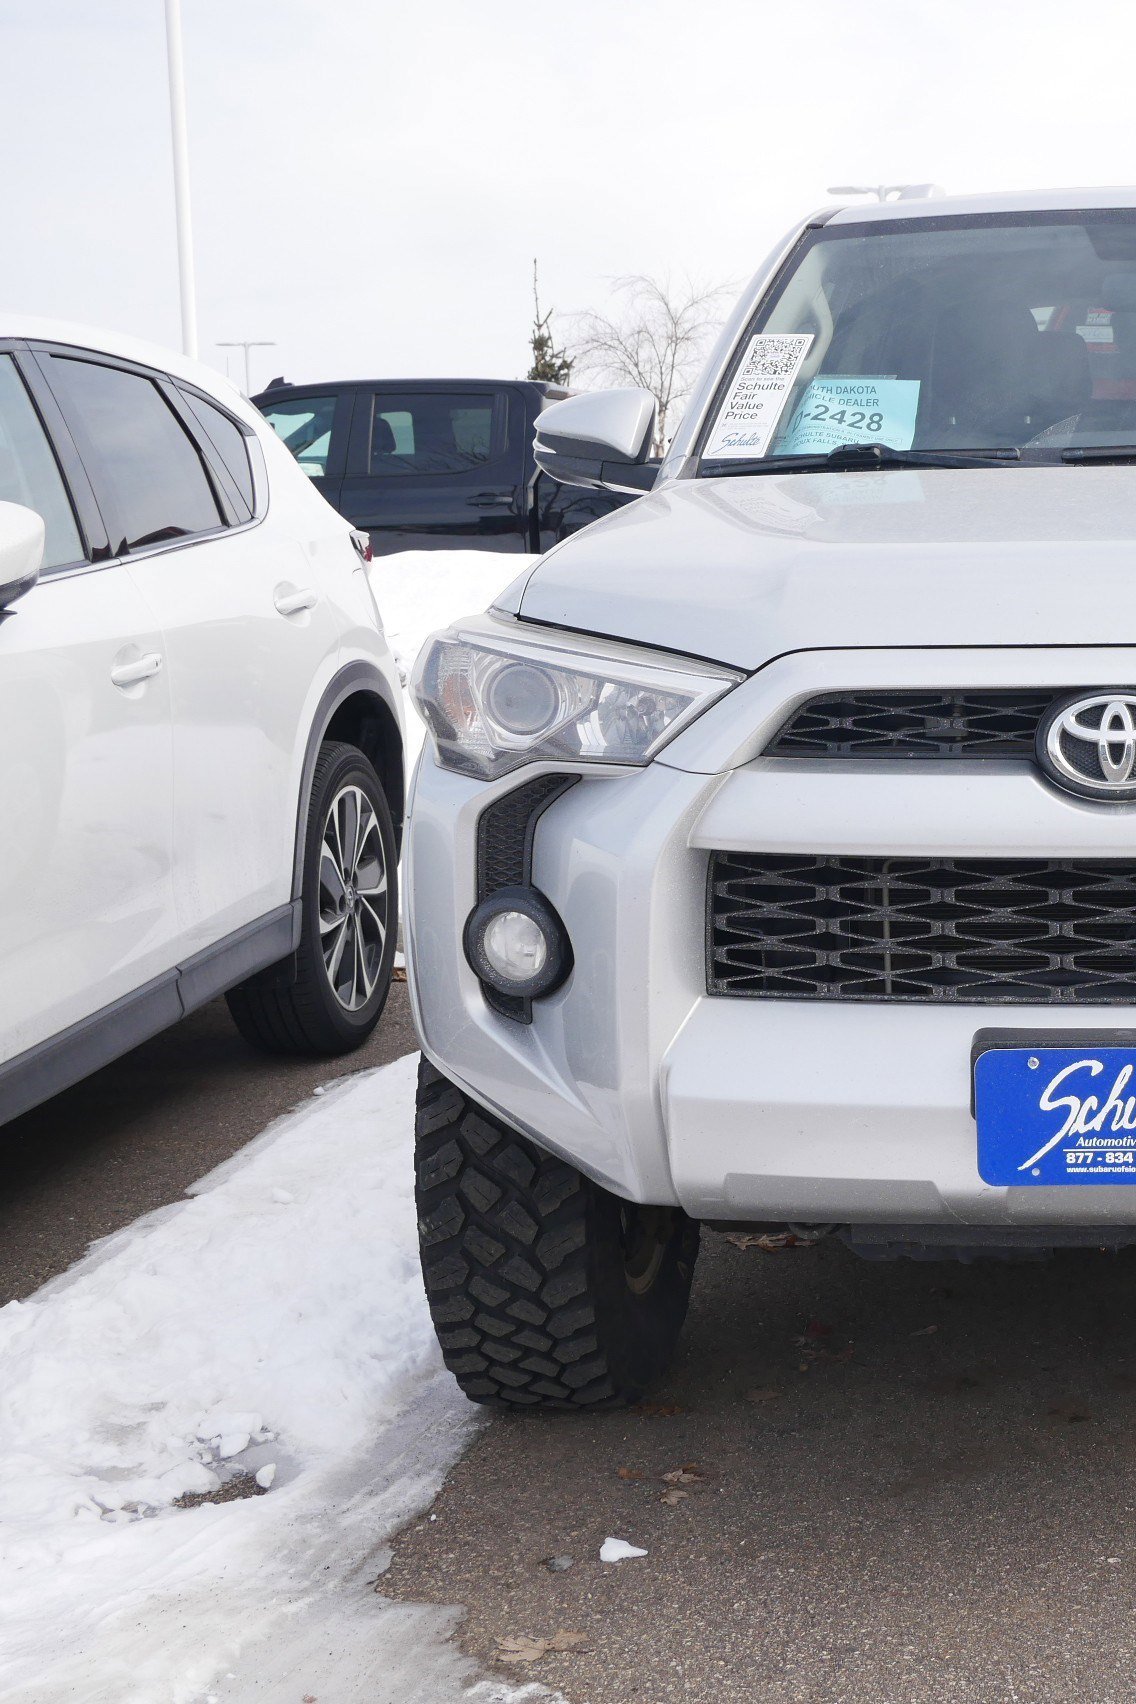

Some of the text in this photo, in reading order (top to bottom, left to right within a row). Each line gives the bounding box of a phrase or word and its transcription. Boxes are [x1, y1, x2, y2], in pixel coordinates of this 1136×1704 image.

[736, 382, 785, 391] Schulte
[809, 384, 877, 395] UTH DAKOTA
[733, 391, 758, 400] Fair
[730, 401, 764, 410] Value
[838, 398, 880, 408] DEALER
[725, 411, 758, 420] Price
[1066, 1152, 1094, 1164] 877
[1105, 1152, 1134, 1164] 834
